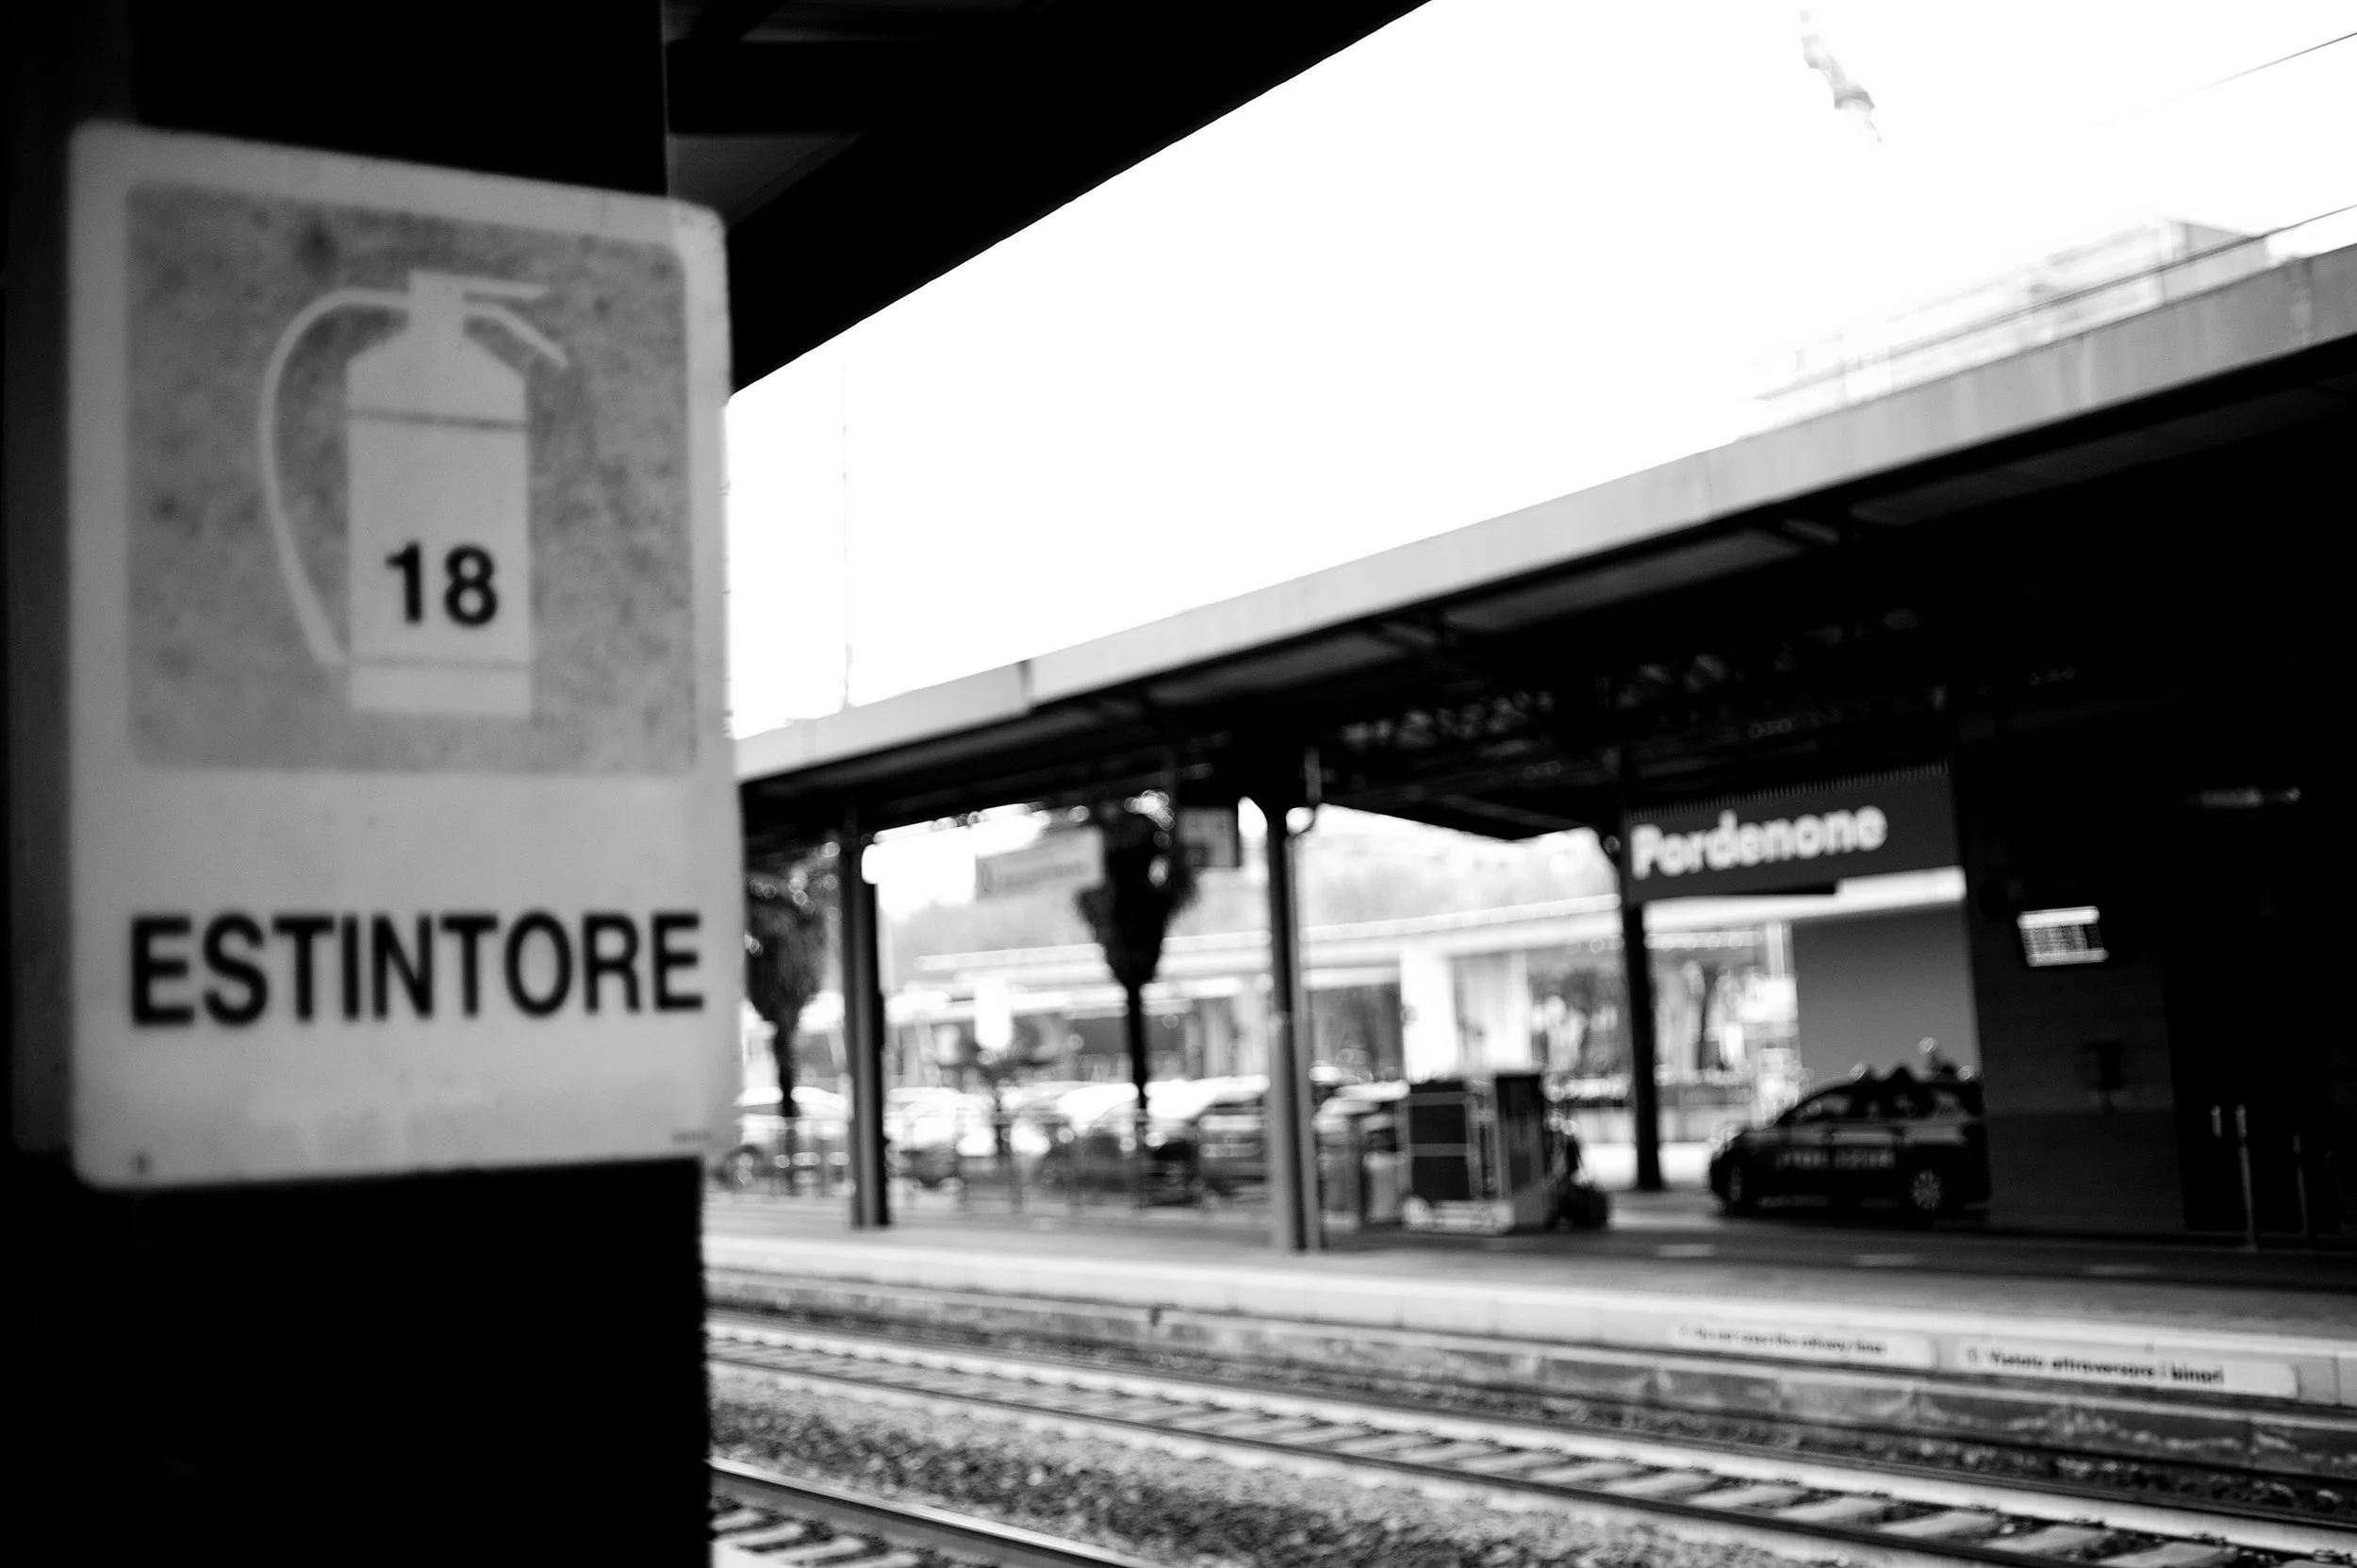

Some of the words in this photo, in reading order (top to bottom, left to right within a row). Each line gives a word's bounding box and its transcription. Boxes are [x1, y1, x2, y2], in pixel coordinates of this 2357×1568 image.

[384, 540, 499, 628] 18
[1630, 805, 1887, 880] Pordenone
[130, 910, 705, 1027] ESTINTORE
